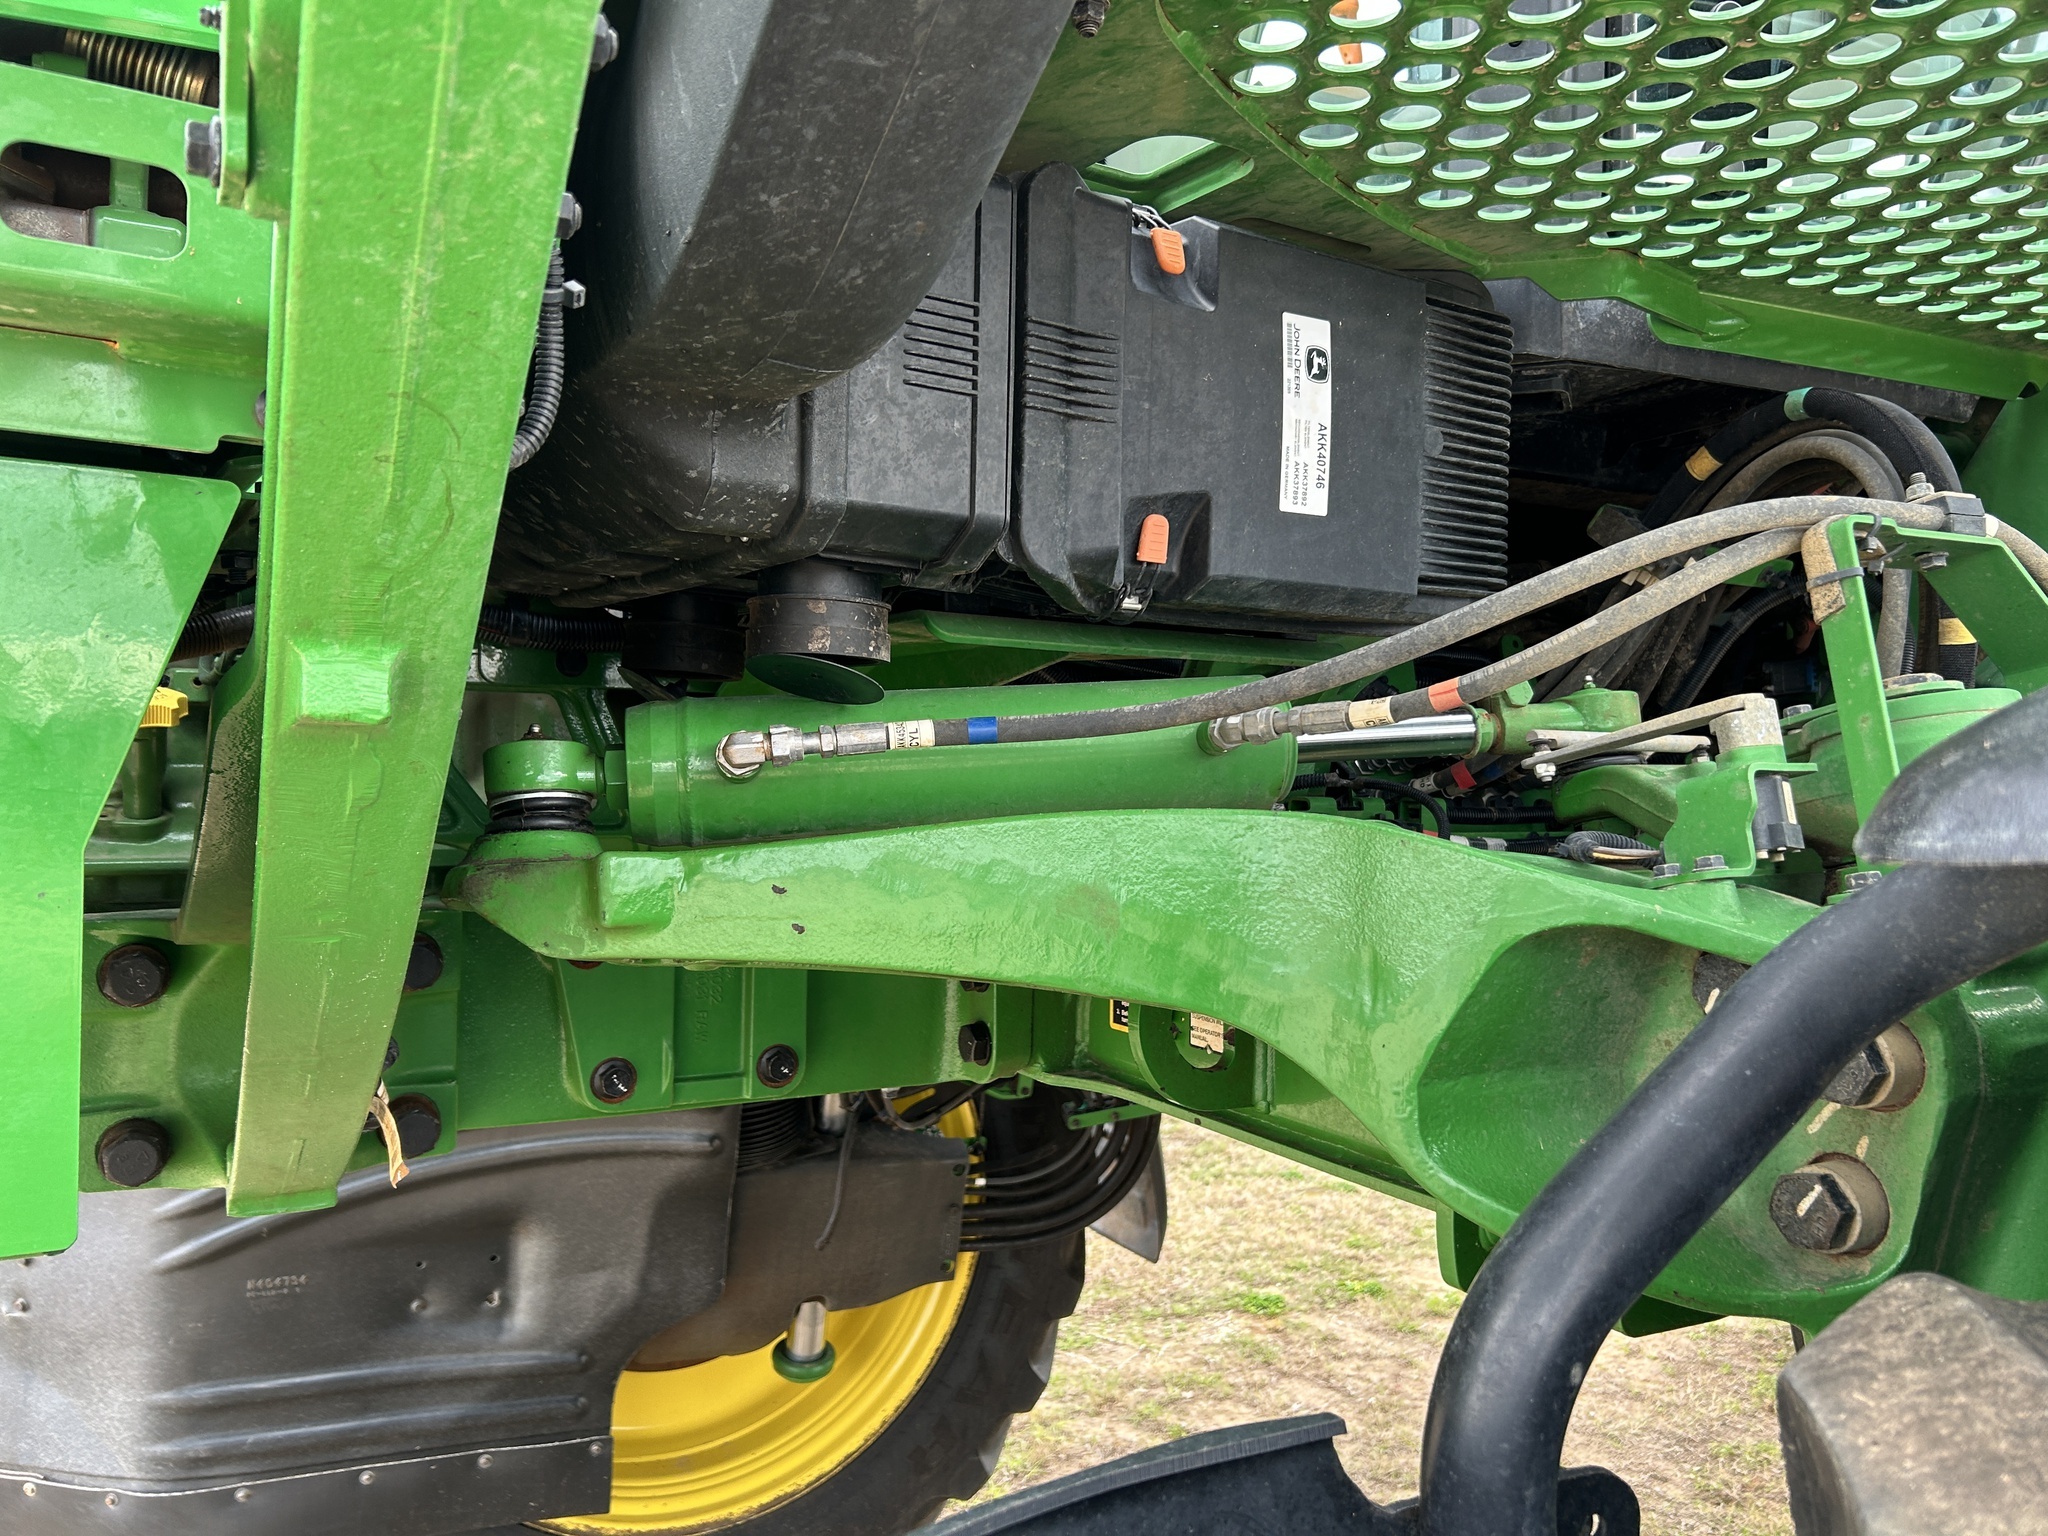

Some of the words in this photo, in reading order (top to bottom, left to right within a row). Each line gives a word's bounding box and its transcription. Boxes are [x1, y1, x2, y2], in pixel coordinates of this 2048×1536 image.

[1293, 323, 1301, 357] JOHN
[1294, 358, 1302, 398] DEERE
[1315, 422, 1328, 489] AKK40746
[1292, 460, 1300, 506] AKK37893
[1301, 461, 1309, 507] AKK37892
[908, 727, 920, 747] CYL
